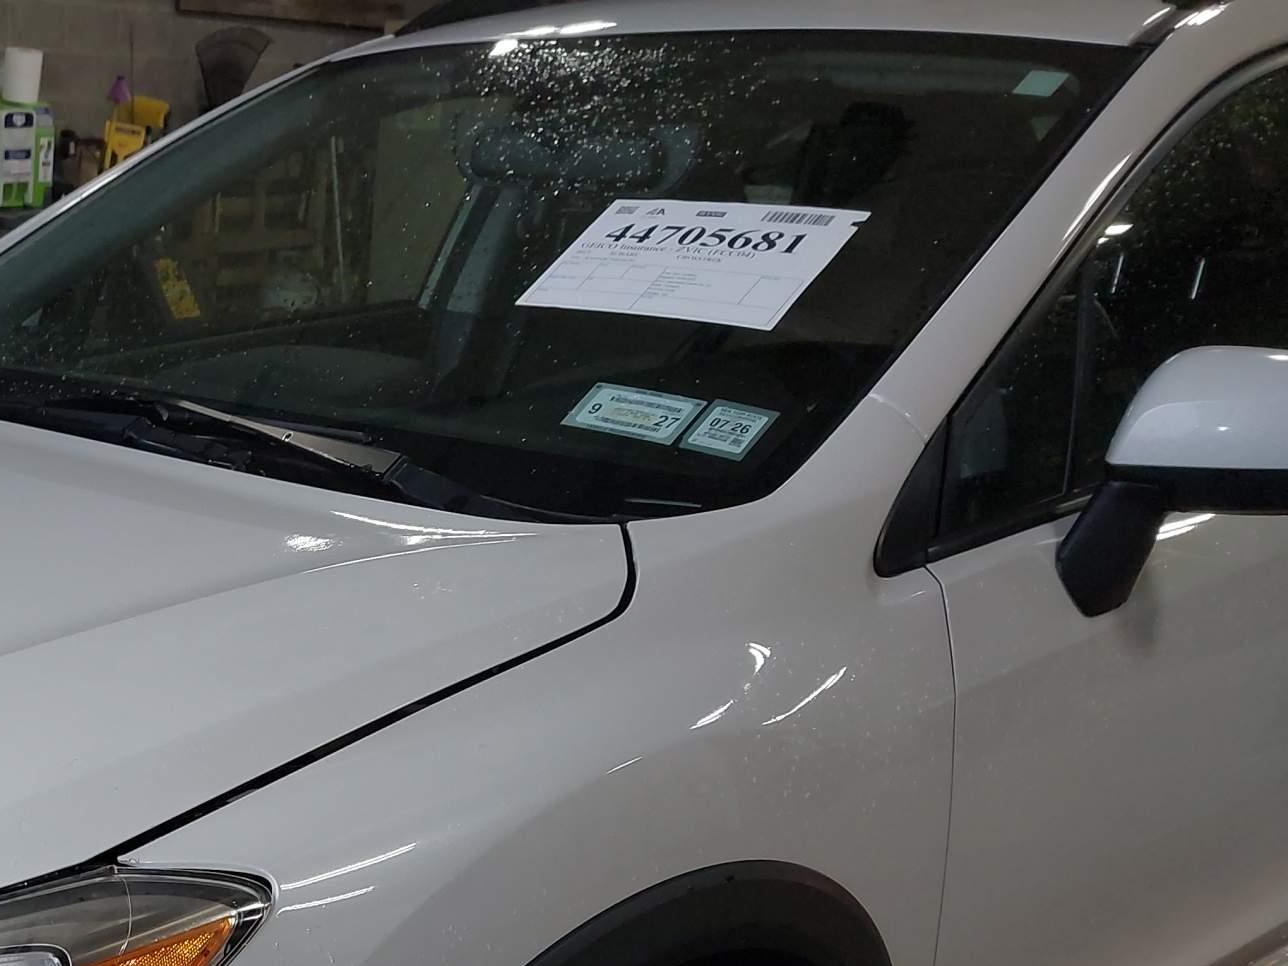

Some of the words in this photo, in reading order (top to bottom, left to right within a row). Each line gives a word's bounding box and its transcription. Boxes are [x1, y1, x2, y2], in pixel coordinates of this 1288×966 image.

[605, 223, 808, 255] 44705681
[588, 402, 603, 415] 9
[653, 415, 681, 429] 27
[709, 417, 728, 430] 07
[731, 422, 753, 435] 26
